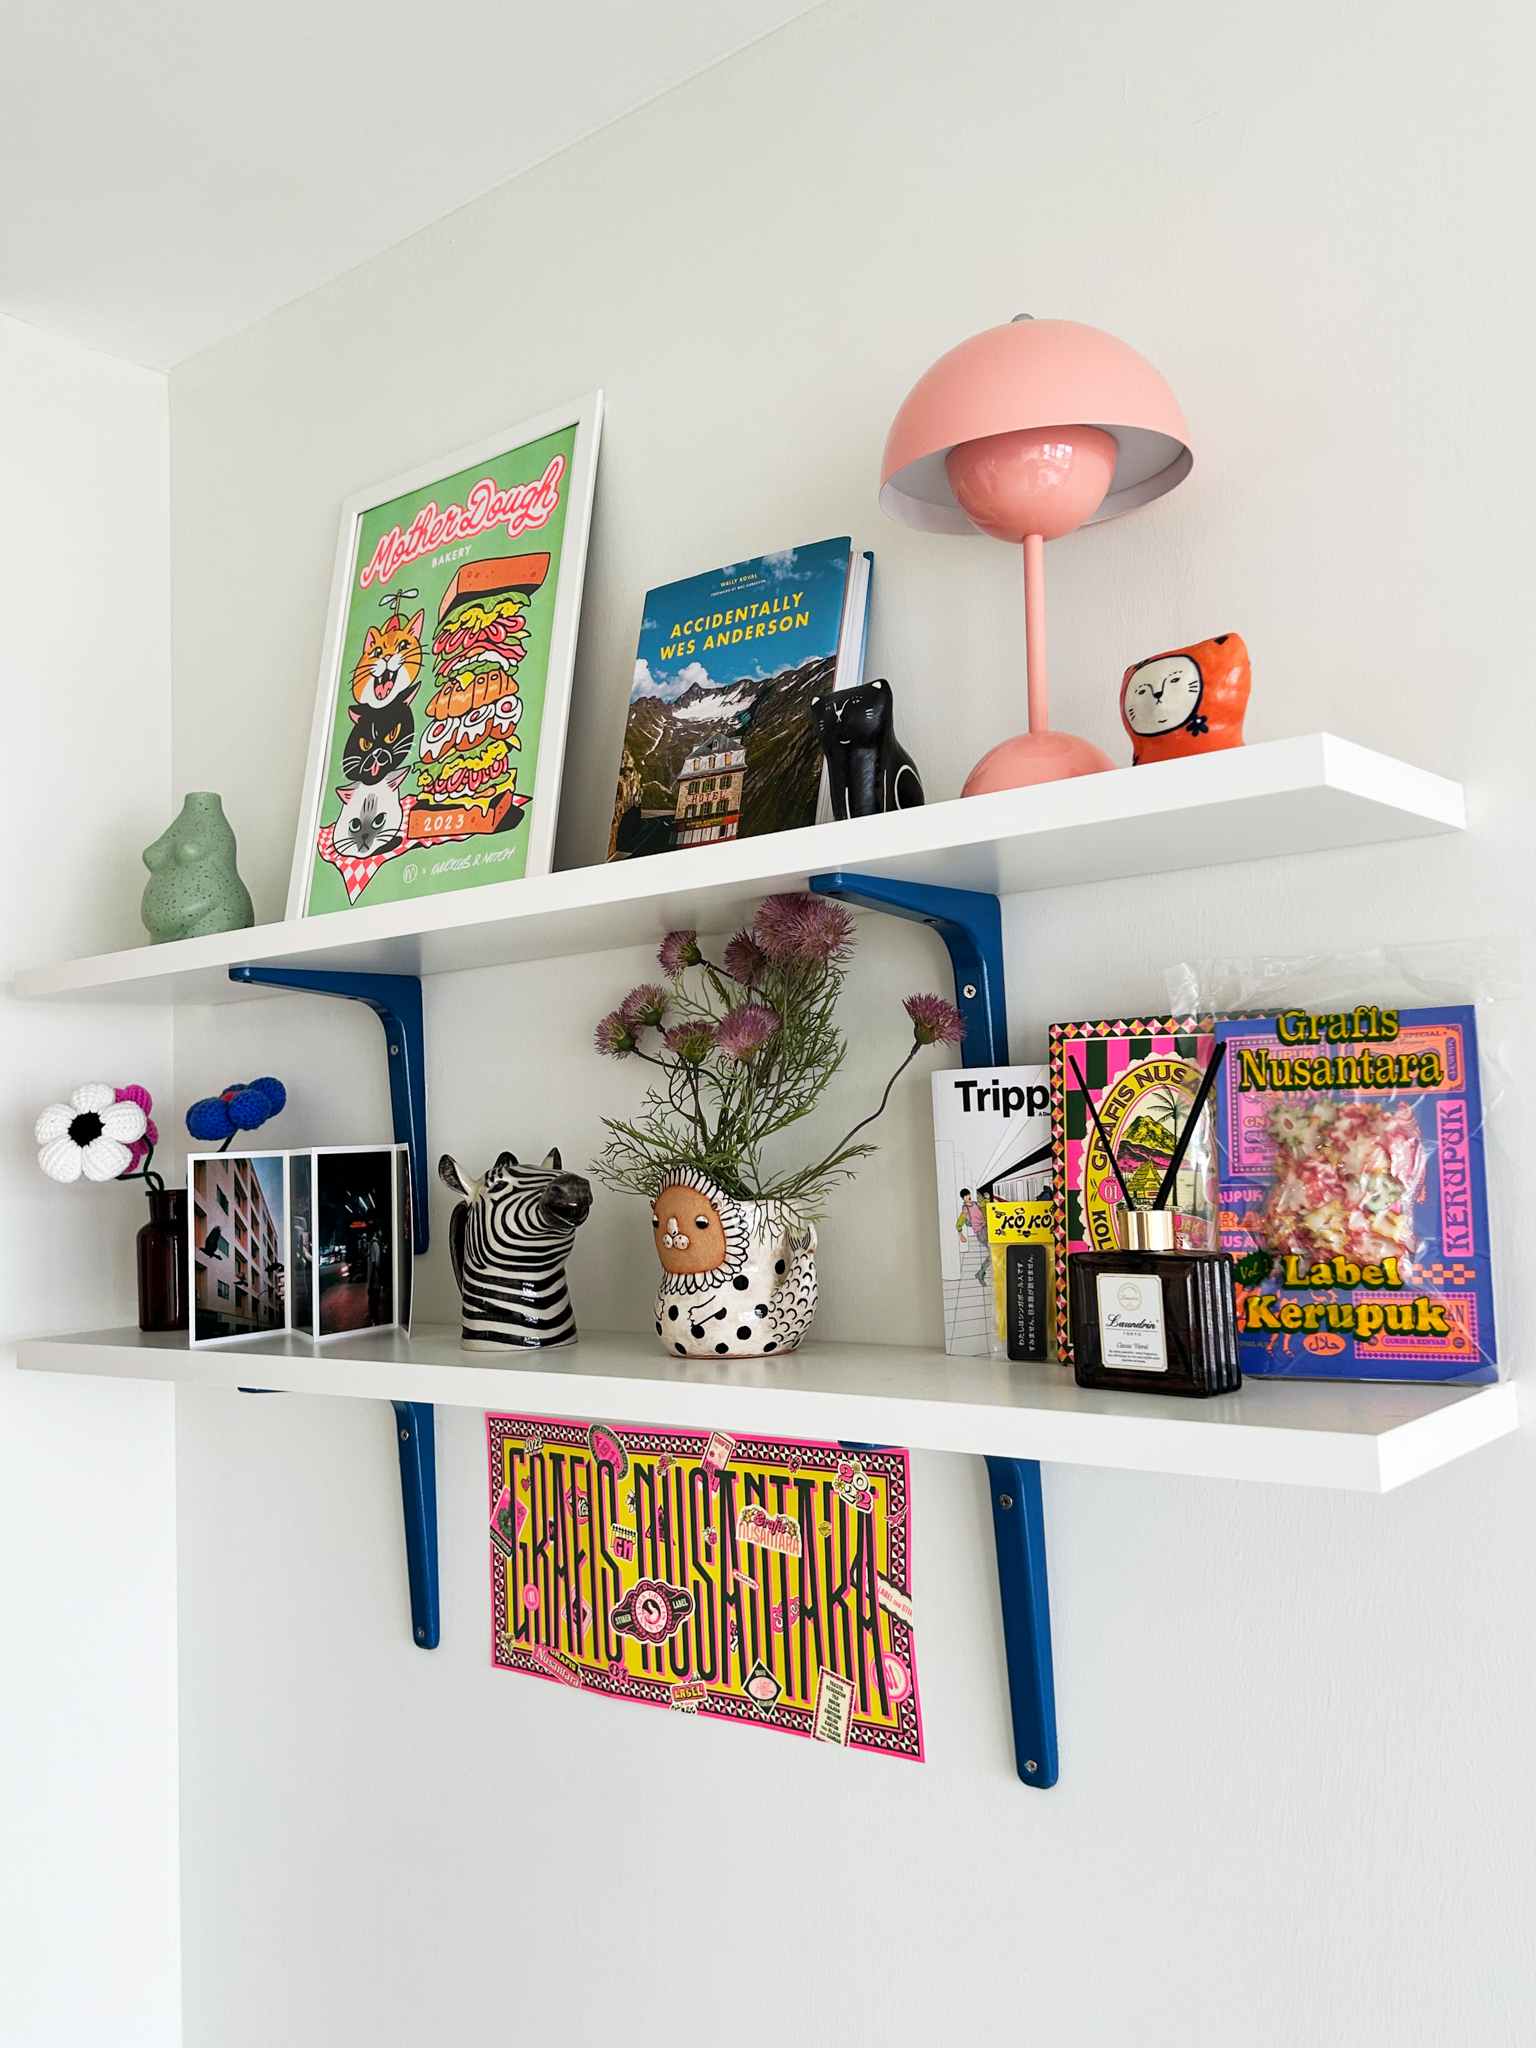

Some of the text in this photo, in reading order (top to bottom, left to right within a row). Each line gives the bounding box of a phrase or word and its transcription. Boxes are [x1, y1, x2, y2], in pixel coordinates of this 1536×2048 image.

[359, 454, 566, 589] Mother Dough
[431, 545, 472, 568] BAKERY
[669, 591, 805, 639] ACCIDENTALLY
[659, 611, 811, 661] WES ANDERSON
[691, 790, 728, 804] HOTEL
[423, 813, 465, 832] 2023
[472, 853, 482, 867] &
[482, 846, 517, 865] NOTCH
[1276, 1006, 1399, 1044] Grafis
[1238, 1048, 1445, 1092] Nusantara
[1104, 1184, 1118, 1200] 01
[1439, 1103, 1471, 1253] KERUPUK
[1281, 1255, 1405, 1290] Label
[1243, 1294, 1451, 1341] Kerupuk
[1308, 1334, 1341, 1352] حلال
[753, 1510, 788, 1536] Grafis
[672, 1598, 689, 1610] LABEL
[535, 1647, 580, 1688] Nusantara
[673, 1686, 704, 1699] LABEL
